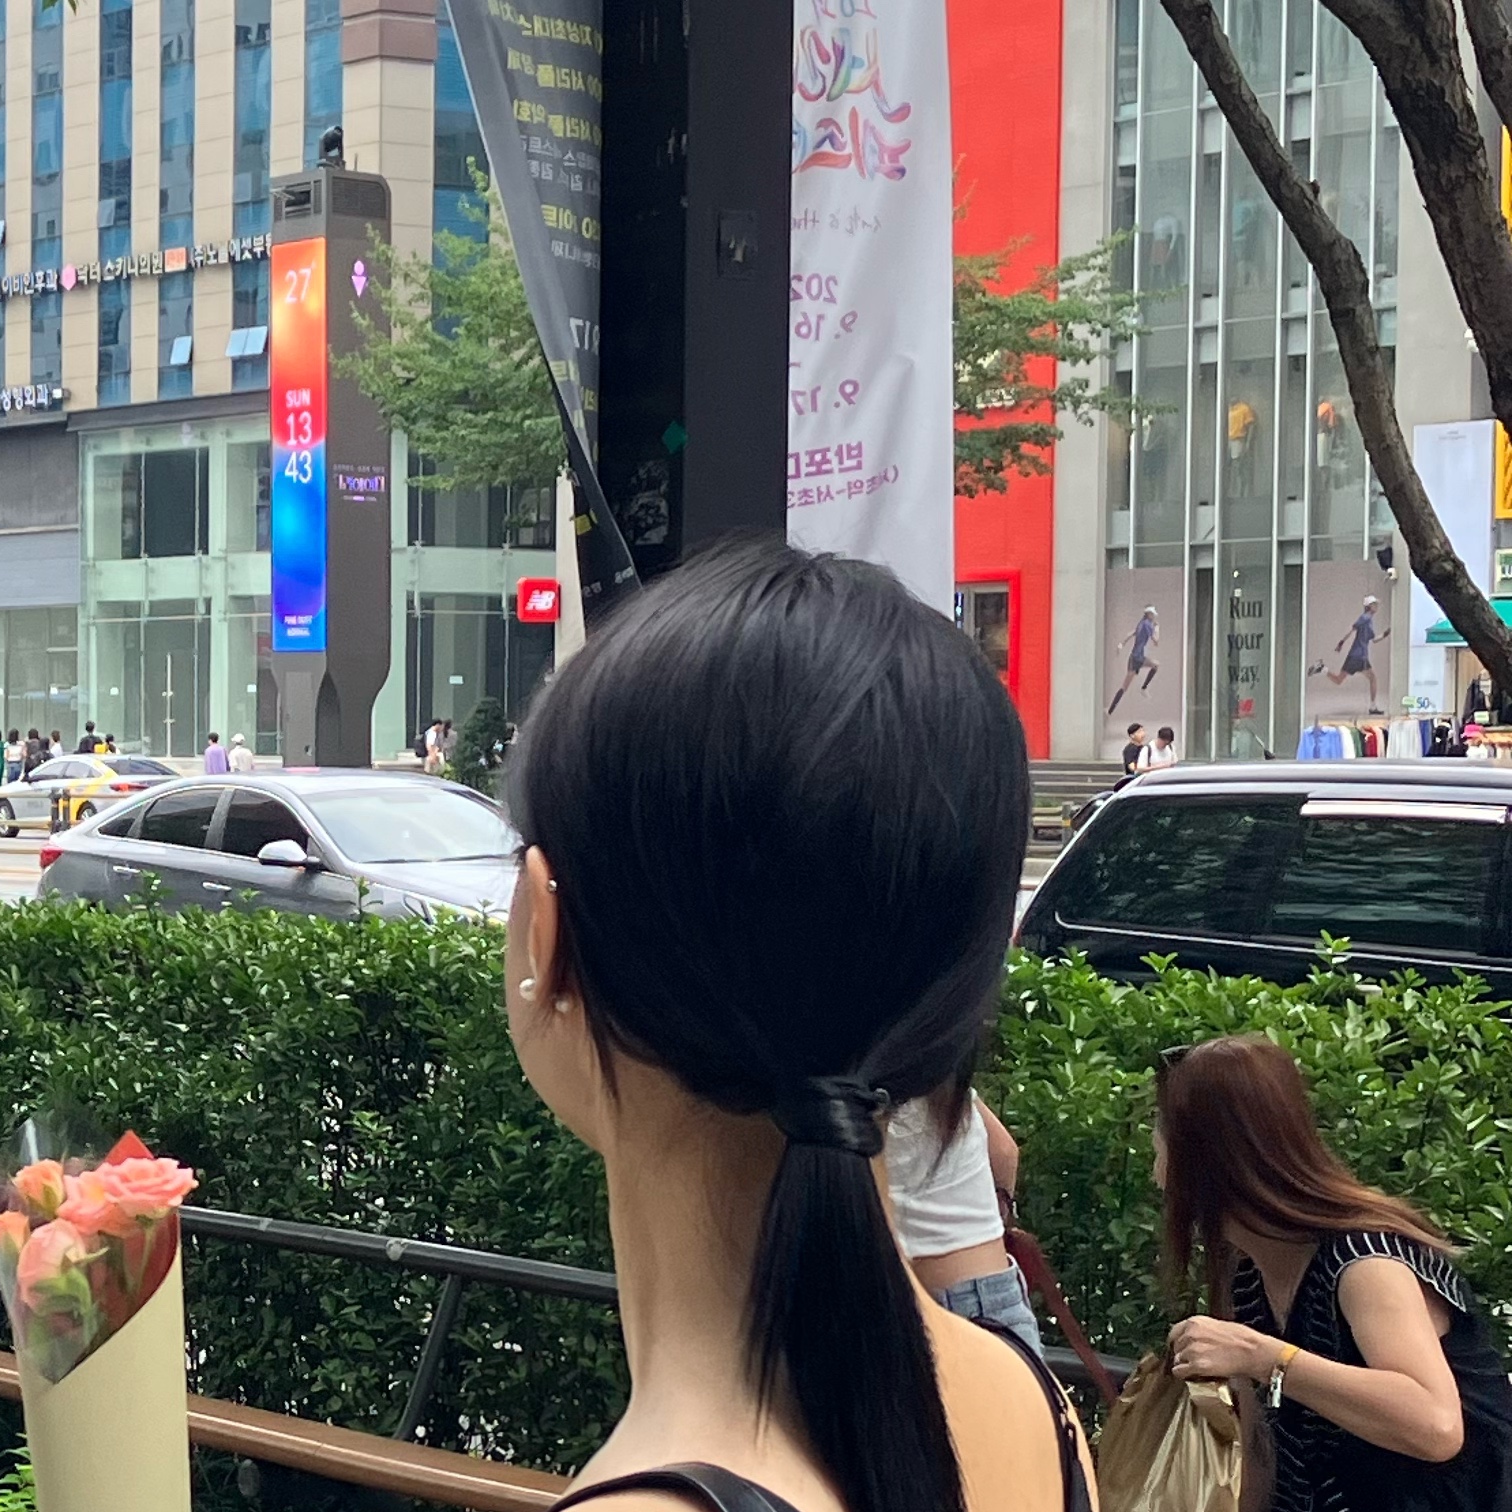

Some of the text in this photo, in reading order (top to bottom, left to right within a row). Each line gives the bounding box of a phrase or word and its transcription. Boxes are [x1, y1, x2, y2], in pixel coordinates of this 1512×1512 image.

[285, 389, 311, 408] SUN
[285, 411, 313, 446] 13
[284, 450, 313, 484] 43
[1229, 596, 1263, 620] Run
[1226, 631, 1265, 658] your
